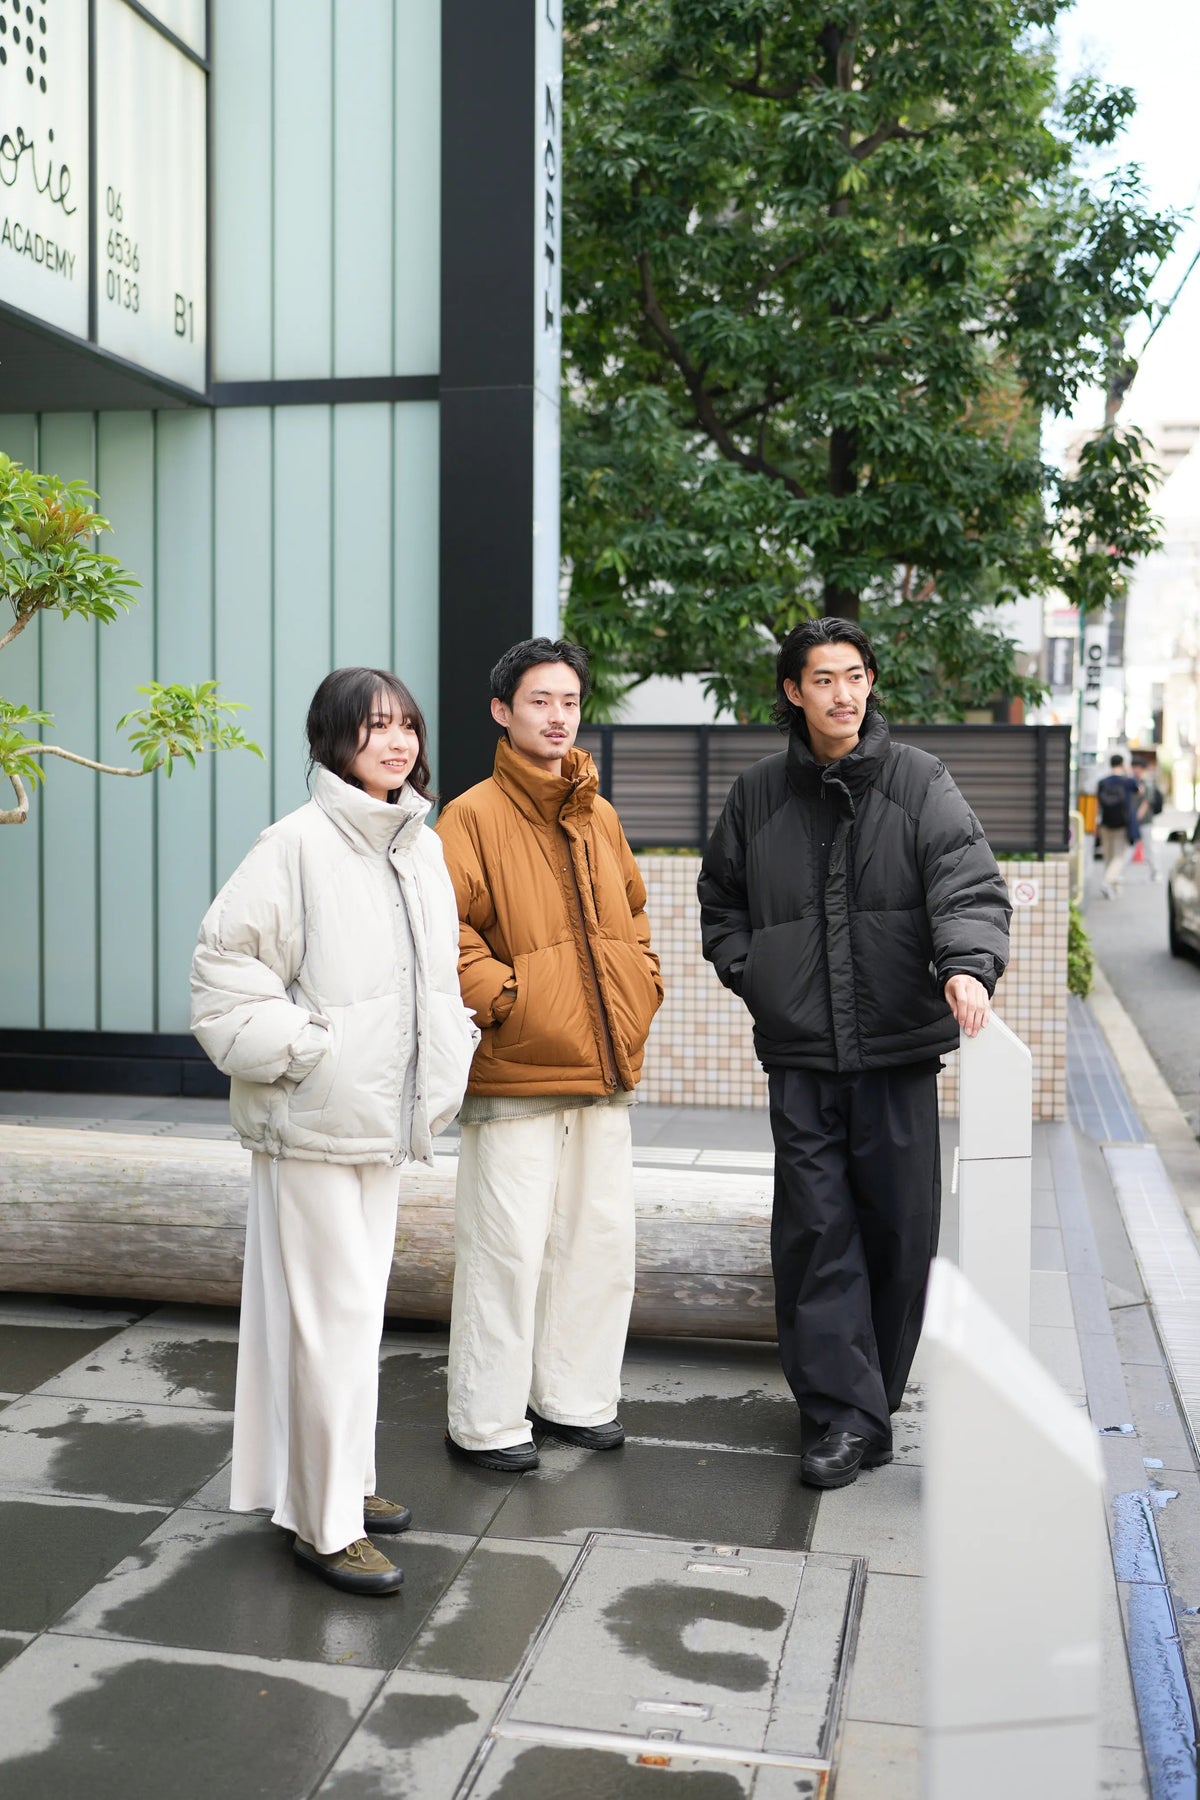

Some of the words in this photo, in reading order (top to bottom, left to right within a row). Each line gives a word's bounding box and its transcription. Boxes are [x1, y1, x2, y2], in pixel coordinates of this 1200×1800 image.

[106, 185, 123, 223] 06
[1, 216, 76, 281] ACADEMY
[107, 227, 140, 274] 6536
[106, 268, 140, 314] 0133
[174, 292, 194, 344] B1
